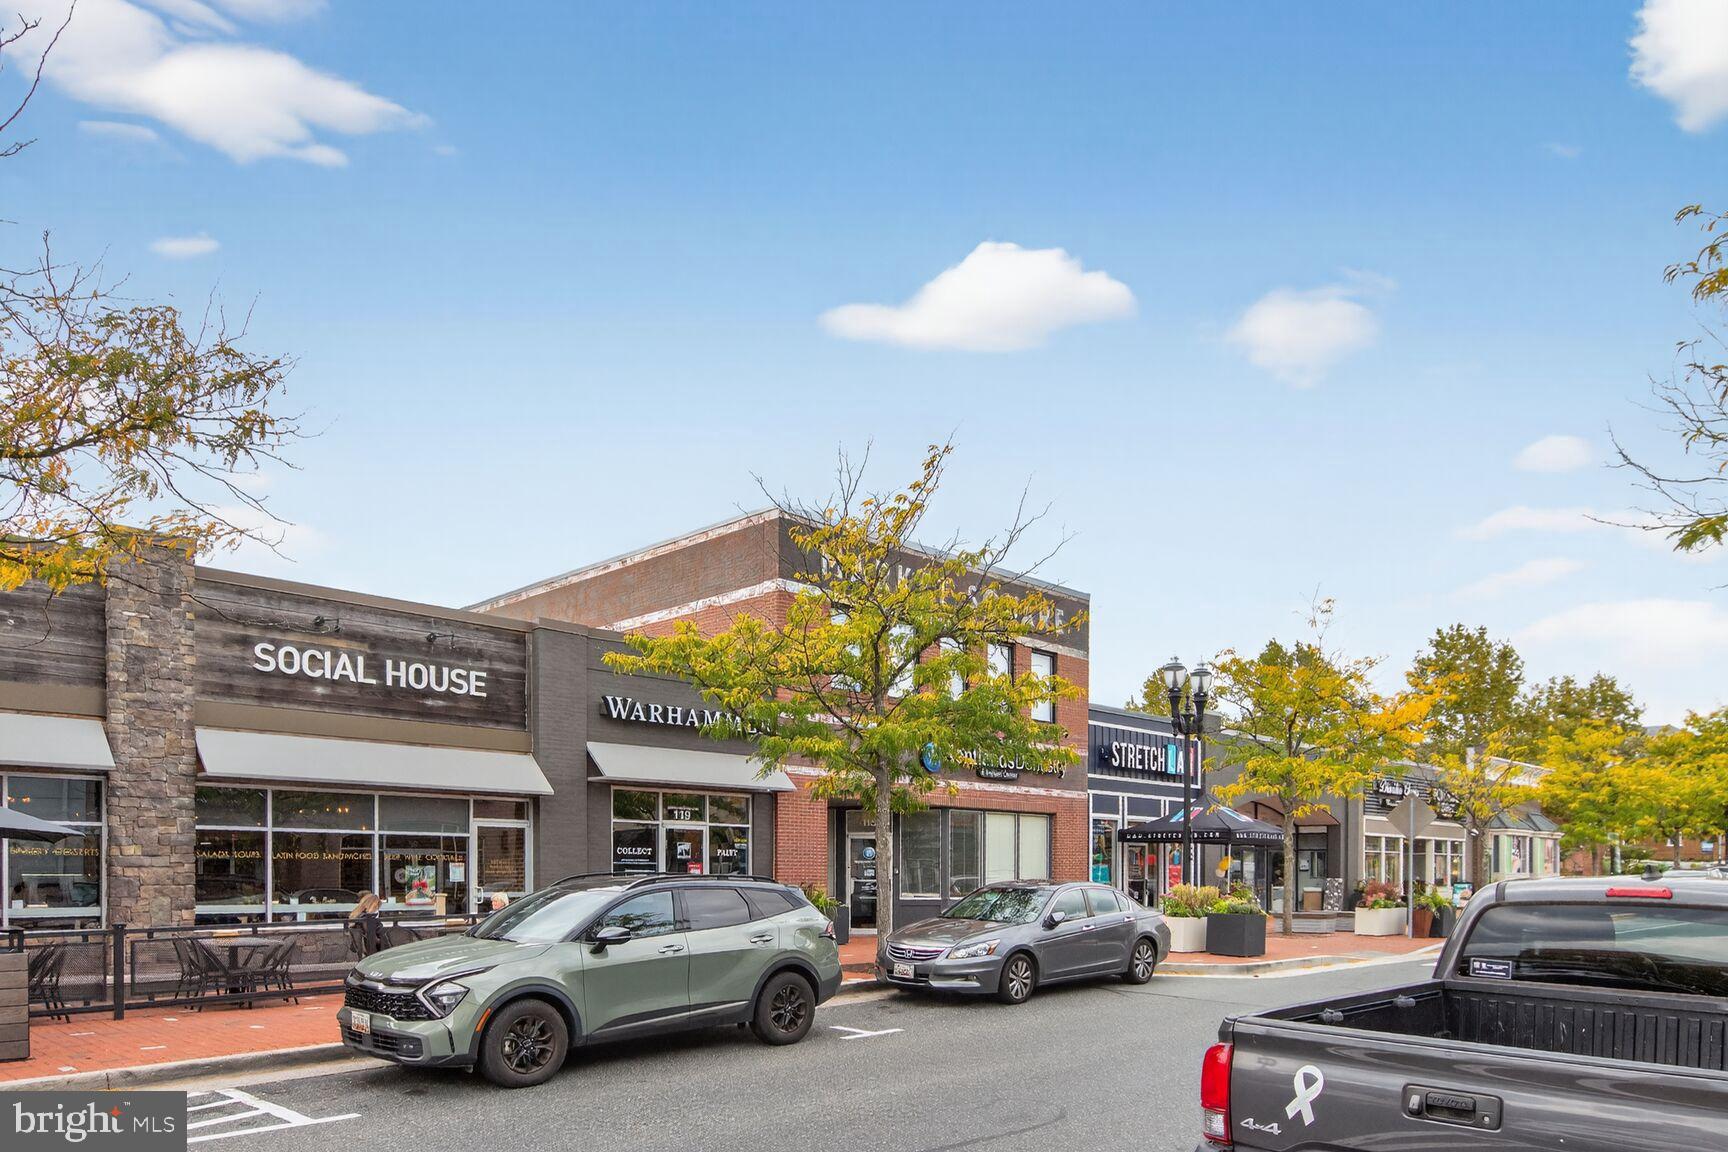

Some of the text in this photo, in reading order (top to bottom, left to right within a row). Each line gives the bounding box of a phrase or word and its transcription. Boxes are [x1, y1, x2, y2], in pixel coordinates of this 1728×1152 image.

[252, 642, 488, 698] SOCIAL HOUSE
[605, 695, 771, 734] WARHAMM
[673, 810, 691, 820] 119
[272, 851, 294, 860] LATIN
[295, 851, 319, 860] FOOD
[616, 846, 653, 856] COLLECT
